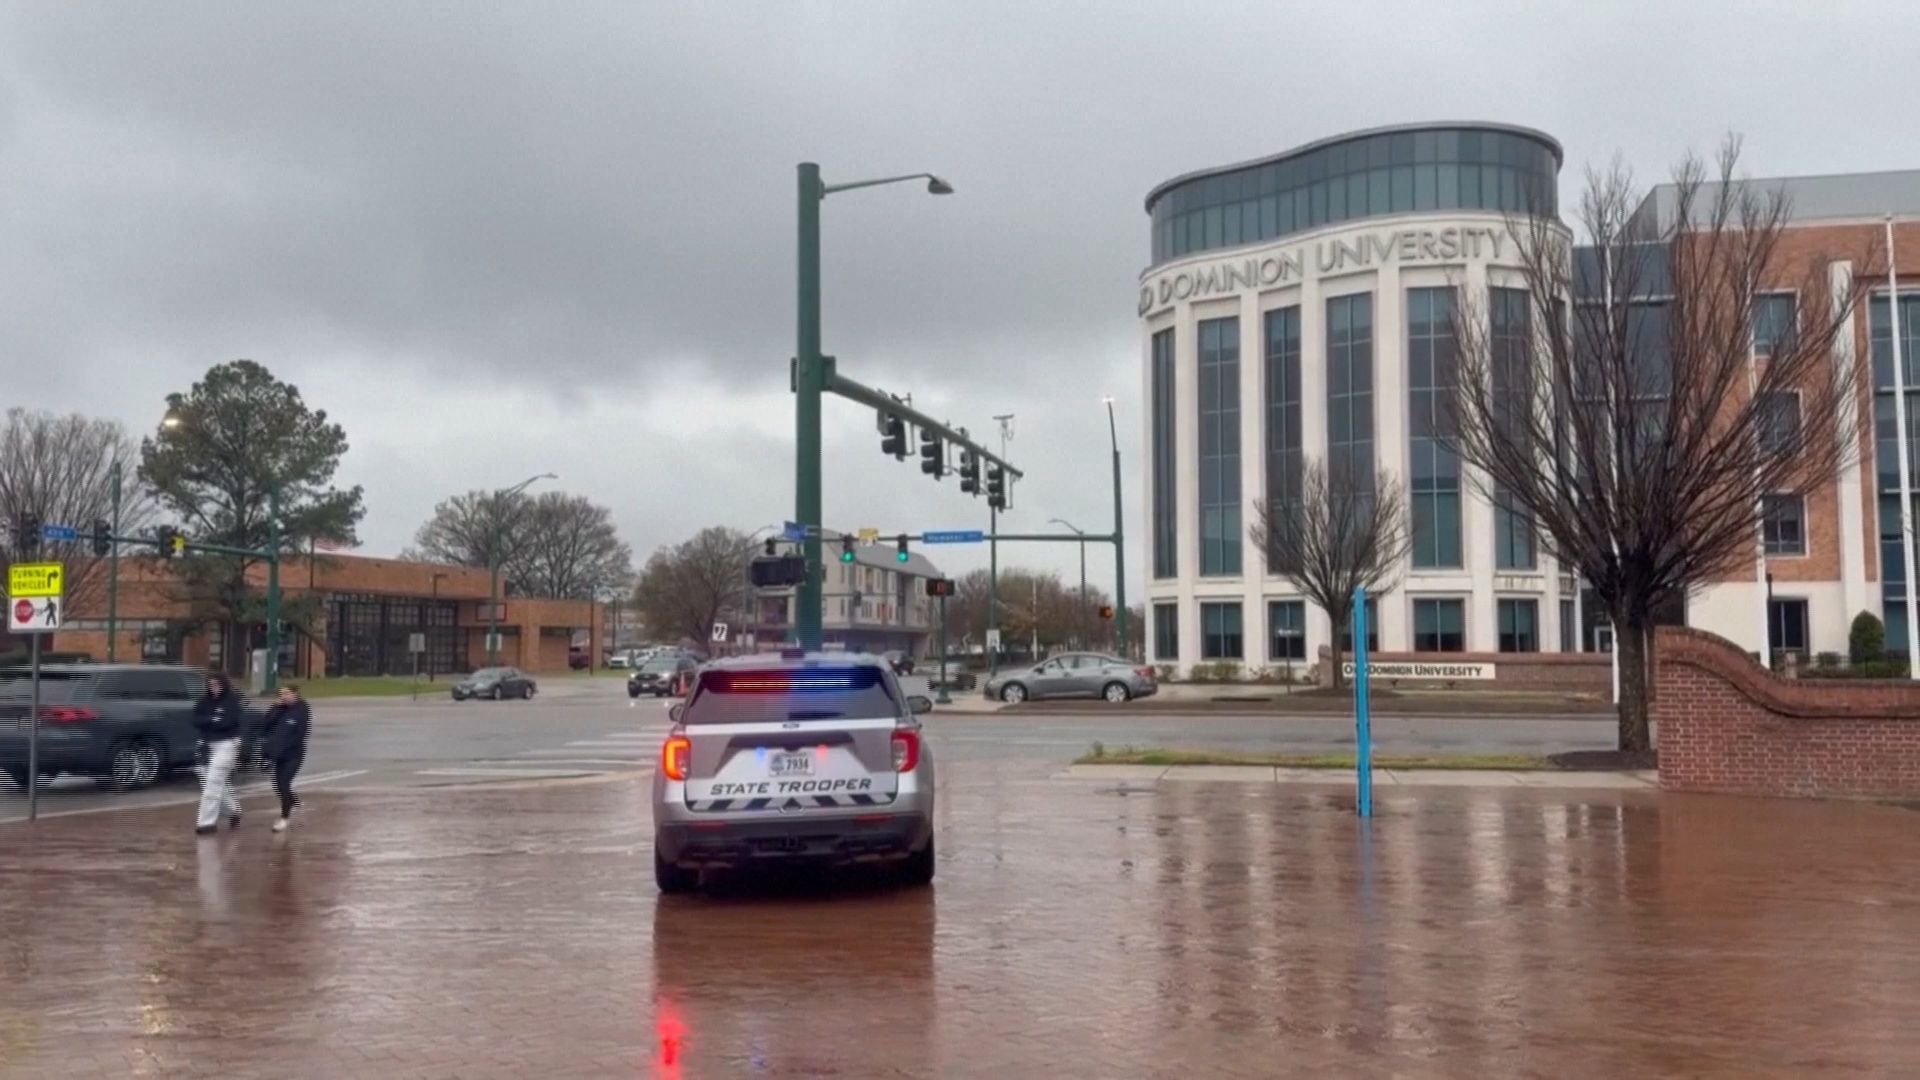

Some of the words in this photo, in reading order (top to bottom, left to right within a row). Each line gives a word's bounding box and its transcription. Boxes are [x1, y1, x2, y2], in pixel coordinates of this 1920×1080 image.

[1159, 250, 1304, 304] DOMINION
[1316, 227, 1507, 273] UNIVERSITY
[13, 569, 46, 578] TURNING
[13, 581, 46, 590] VEHICLES
[1414, 664, 1482, 676] UNIVERSITY
[710, 781, 770, 796] STATE
[778, 777, 872, 793] TROOPER
